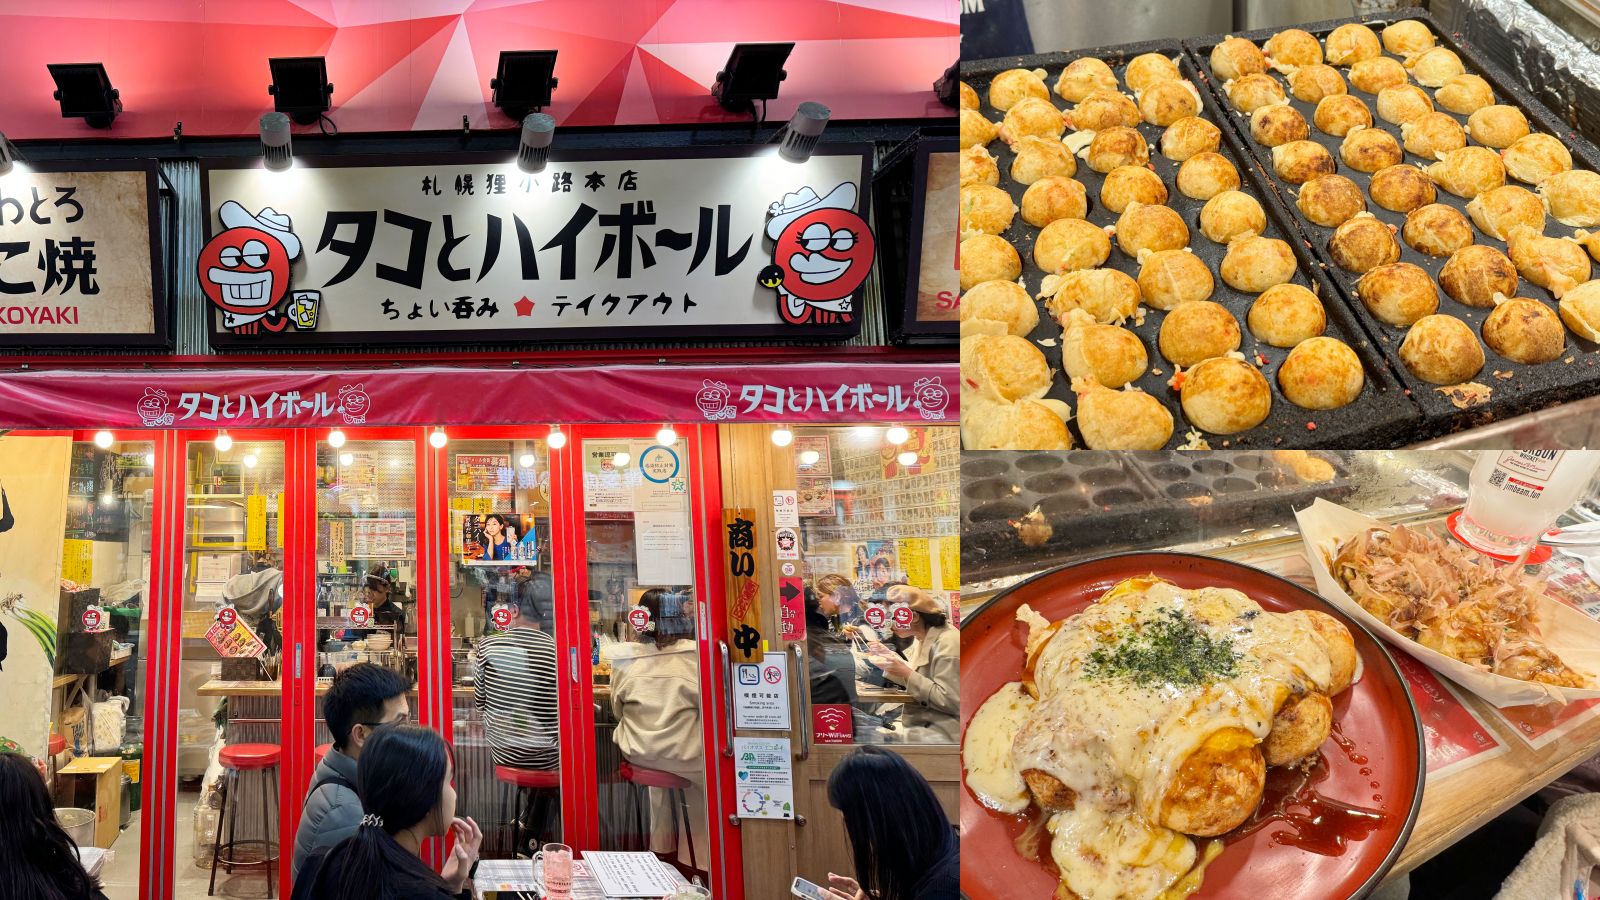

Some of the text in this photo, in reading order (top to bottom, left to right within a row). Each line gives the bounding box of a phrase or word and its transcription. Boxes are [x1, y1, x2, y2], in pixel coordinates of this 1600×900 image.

[421, 169, 639, 196] 札幌狸小路本店
[381, 292, 697, 320] ちょい呑み テイクアウト
[177, 390, 336, 422] タコとハイボール
[738, 383, 911, 415] タコとハイボール
[1503, 483, 1541, 499] jimbeam.fun
